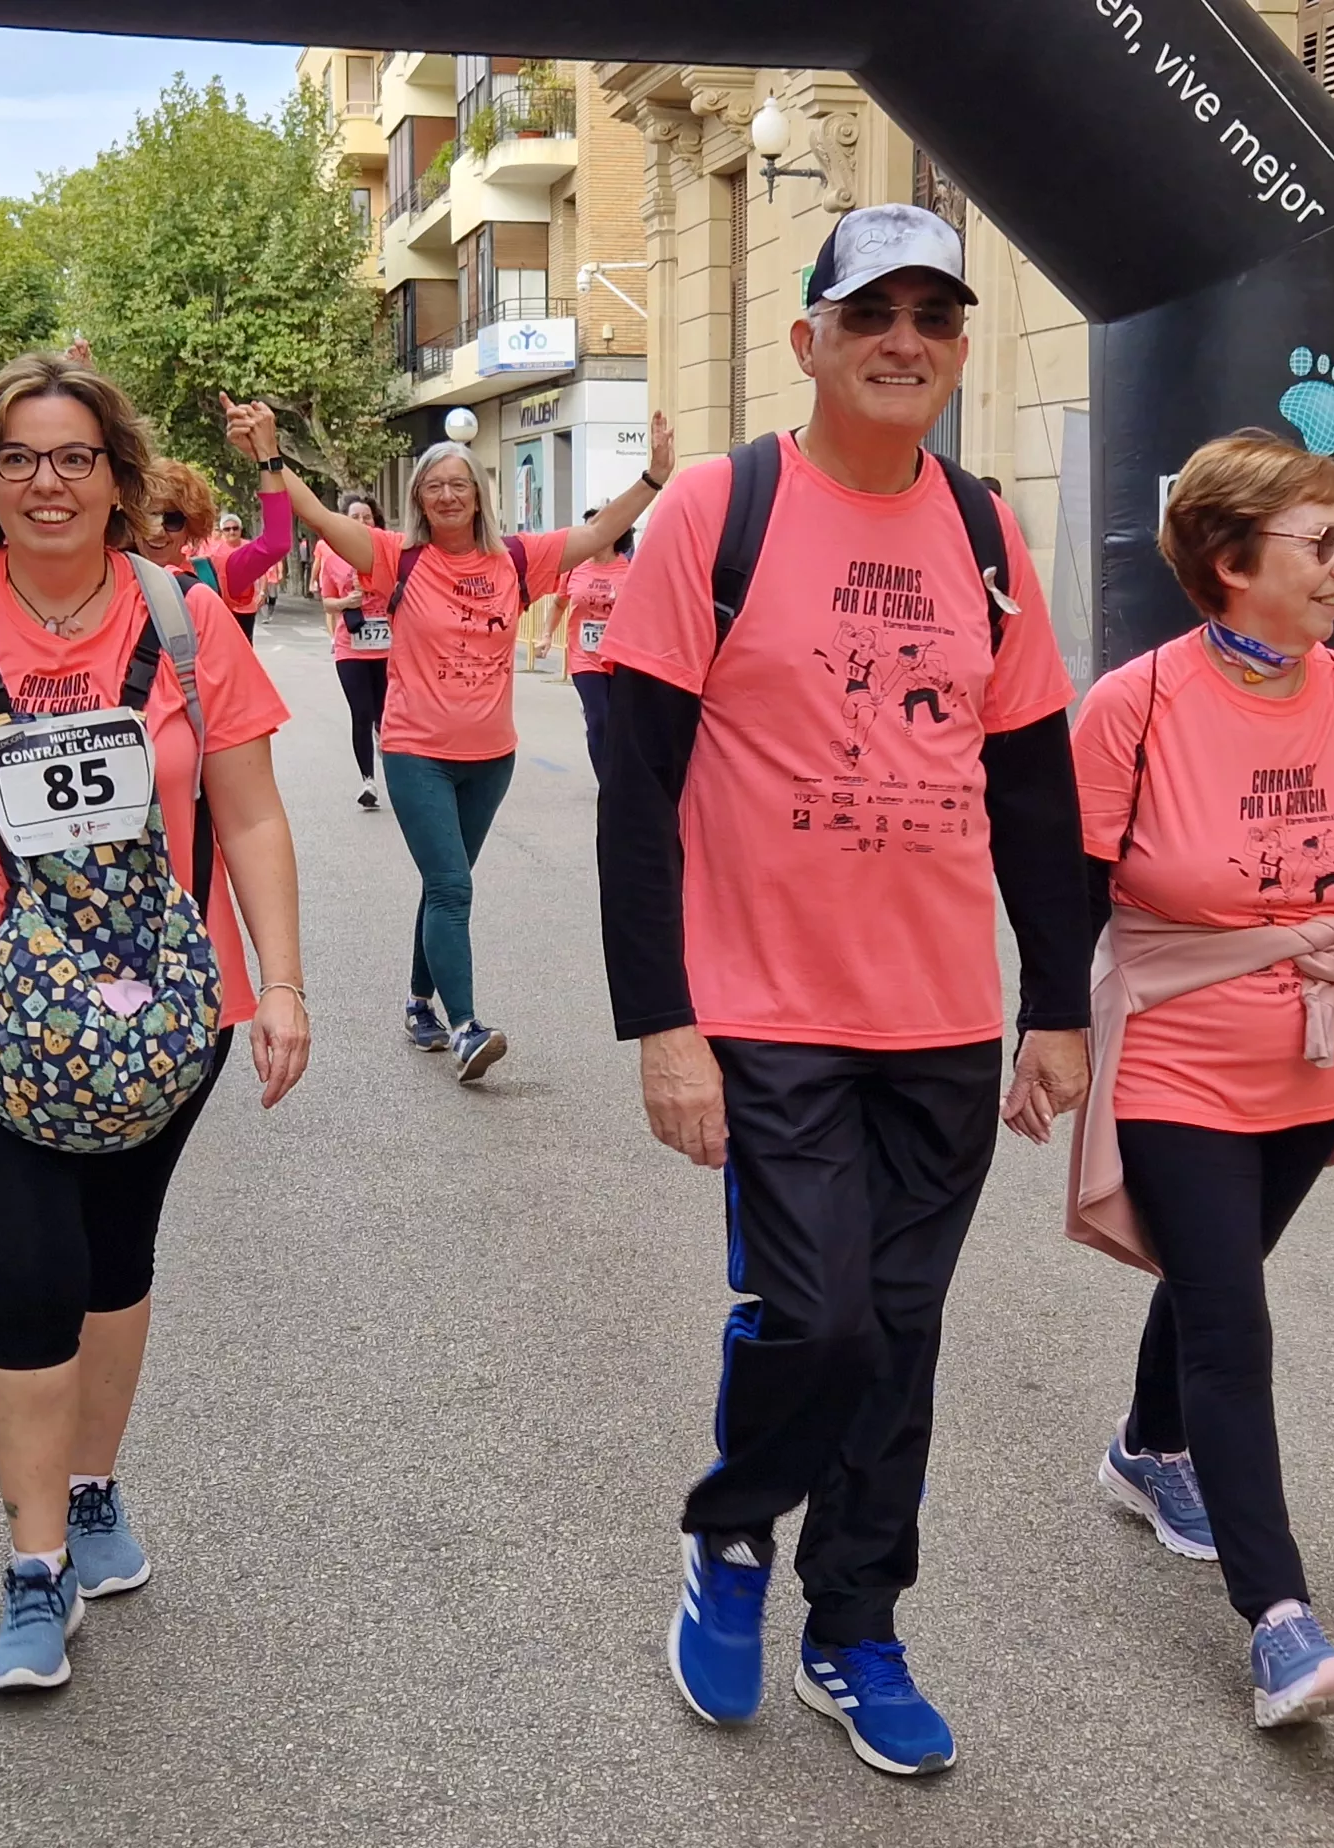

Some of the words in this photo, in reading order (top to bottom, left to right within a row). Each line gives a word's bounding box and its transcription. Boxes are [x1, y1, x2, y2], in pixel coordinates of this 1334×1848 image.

[1096, 0, 1144, 54] en,
[1154, 42, 1221, 122] vive
[1219, 118, 1325, 223] mejor
[520, 398, 560, 428] VITALDENT
[848, 561, 922, 593] CORRAMOS
[832, 587, 859, 614] POR
[863, 590, 877, 616] LA
[882, 592, 935, 622] CIENCIA
[585, 631, 605, 644] 15
[19, 672, 90, 699] CORRAMOS
[9, 697, 31, 713] OR
[50, 694, 101, 713] CIENCIA
[1, 744, 63, 765] CONTRA
[66, 741, 82, 755] EL
[84, 732, 138, 752] CÁNCER
[49, 728, 91, 745] HUESCA
[43, 758, 115, 811] 85
[1252, 763, 1317, 794] CORRAMO
[1240, 795, 1264, 821] POR
[1269, 795, 1282, 817] LA
